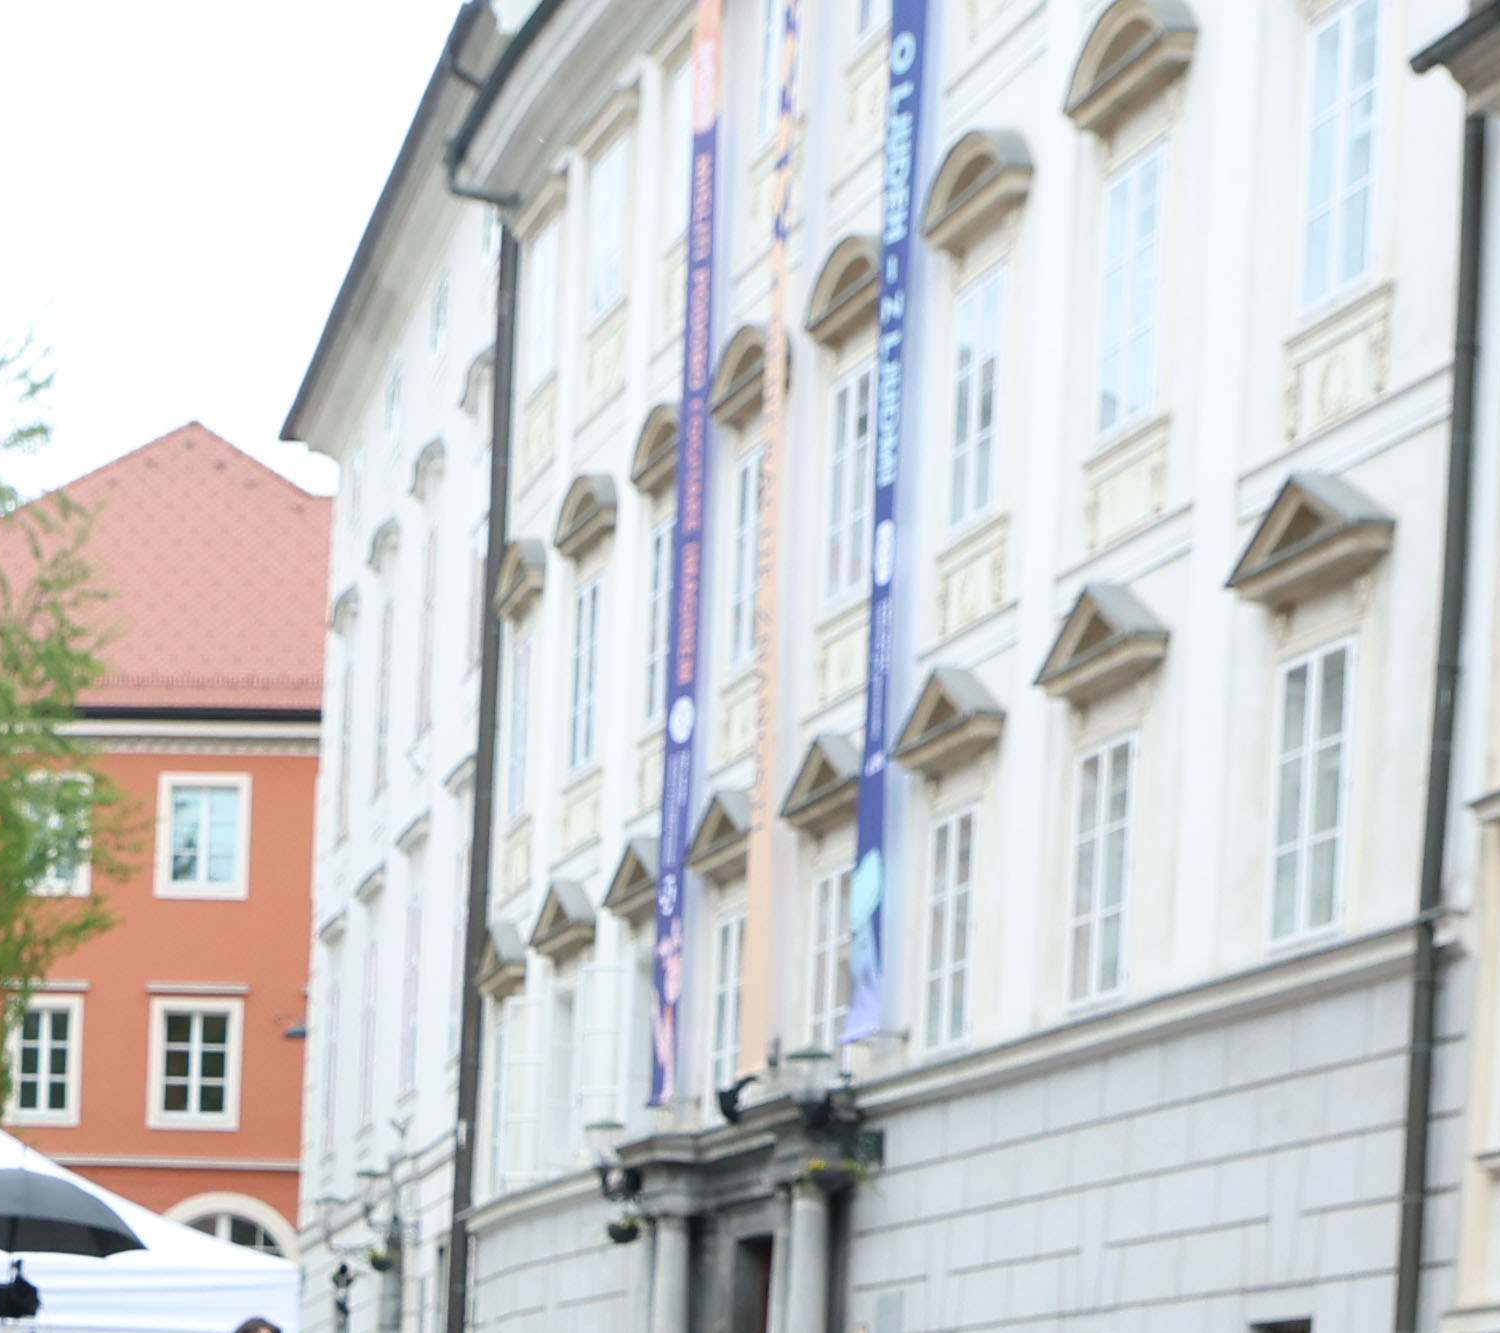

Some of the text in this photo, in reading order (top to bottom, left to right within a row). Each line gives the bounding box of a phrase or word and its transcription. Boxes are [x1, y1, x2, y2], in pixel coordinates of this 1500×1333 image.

[890, 30, 917, 75] O
[883, 79, 915, 246] LJUDEH
[877, 328, 903, 488] LJUDMI
